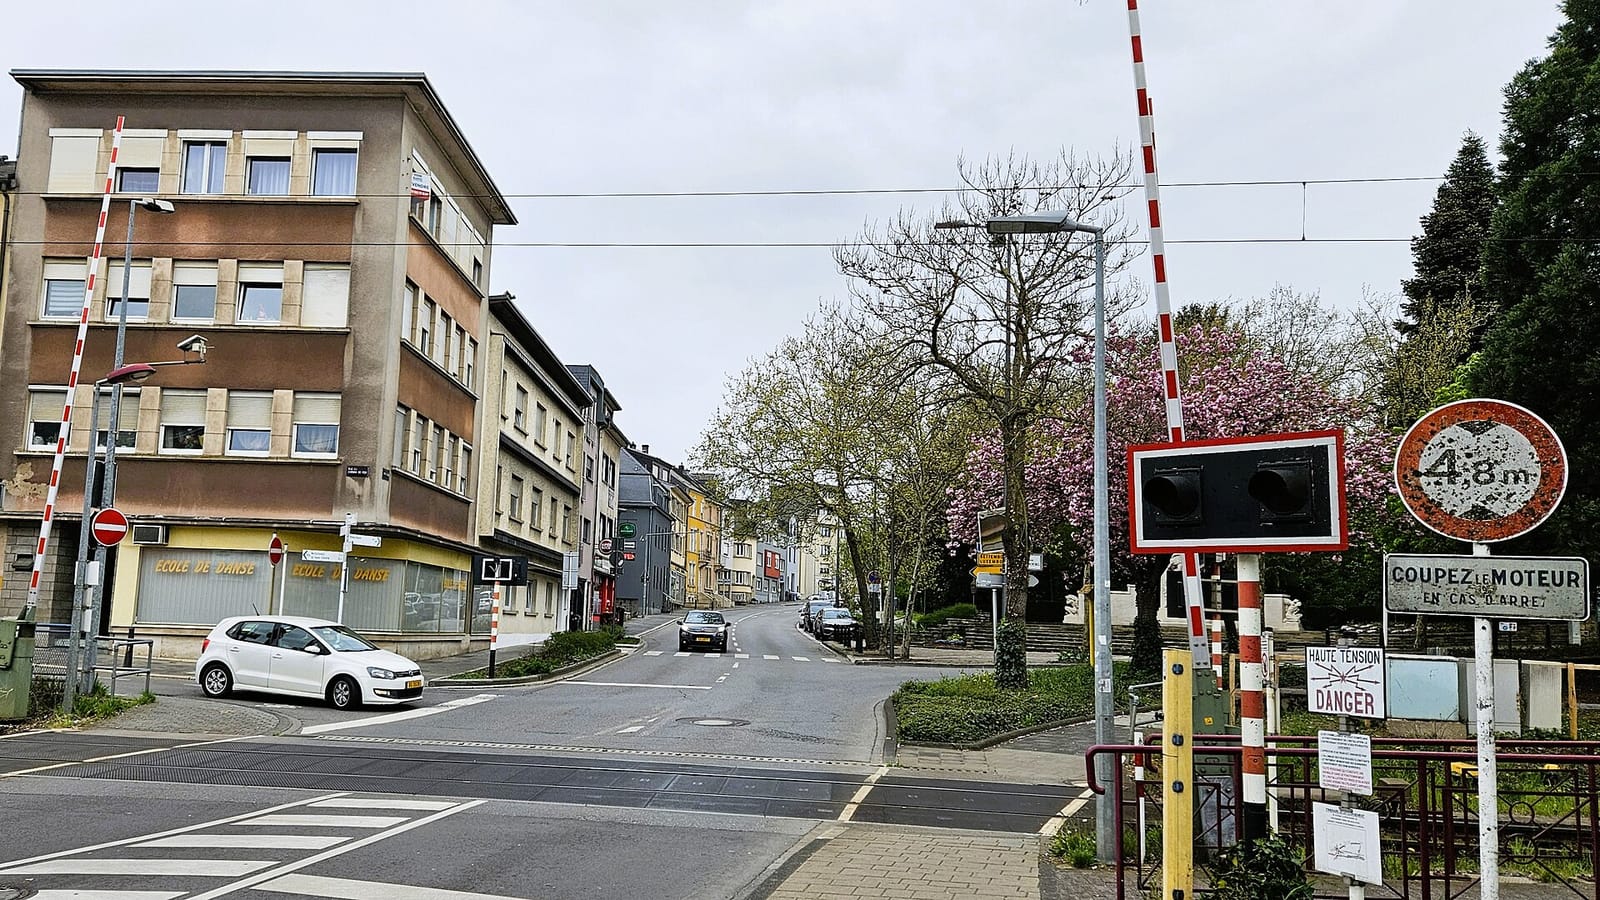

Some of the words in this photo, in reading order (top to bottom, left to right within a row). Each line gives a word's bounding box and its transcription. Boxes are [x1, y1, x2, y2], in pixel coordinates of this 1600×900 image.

[155, 560, 190, 573] ECOLE
[194, 561, 210, 573] DE
[215, 562, 255, 575] DANSE
[292, 565, 325, 578] ECOLE
[331, 567, 345, 580] D
[354, 569, 390, 582] DANSE
[1392, 566, 1474, 585] COUPEZ
[1475, 573, 1490, 585] LE
[1491, 568, 1580, 588] MOTEUR
[1423, 592, 1441, 606] EN
[1449, 593, 1476, 605] CAS
[1309, 649, 1337, 663] HAUTE
[1340, 649, 1381, 665] TENSION
[1316, 689, 1375, 715] DANGER
